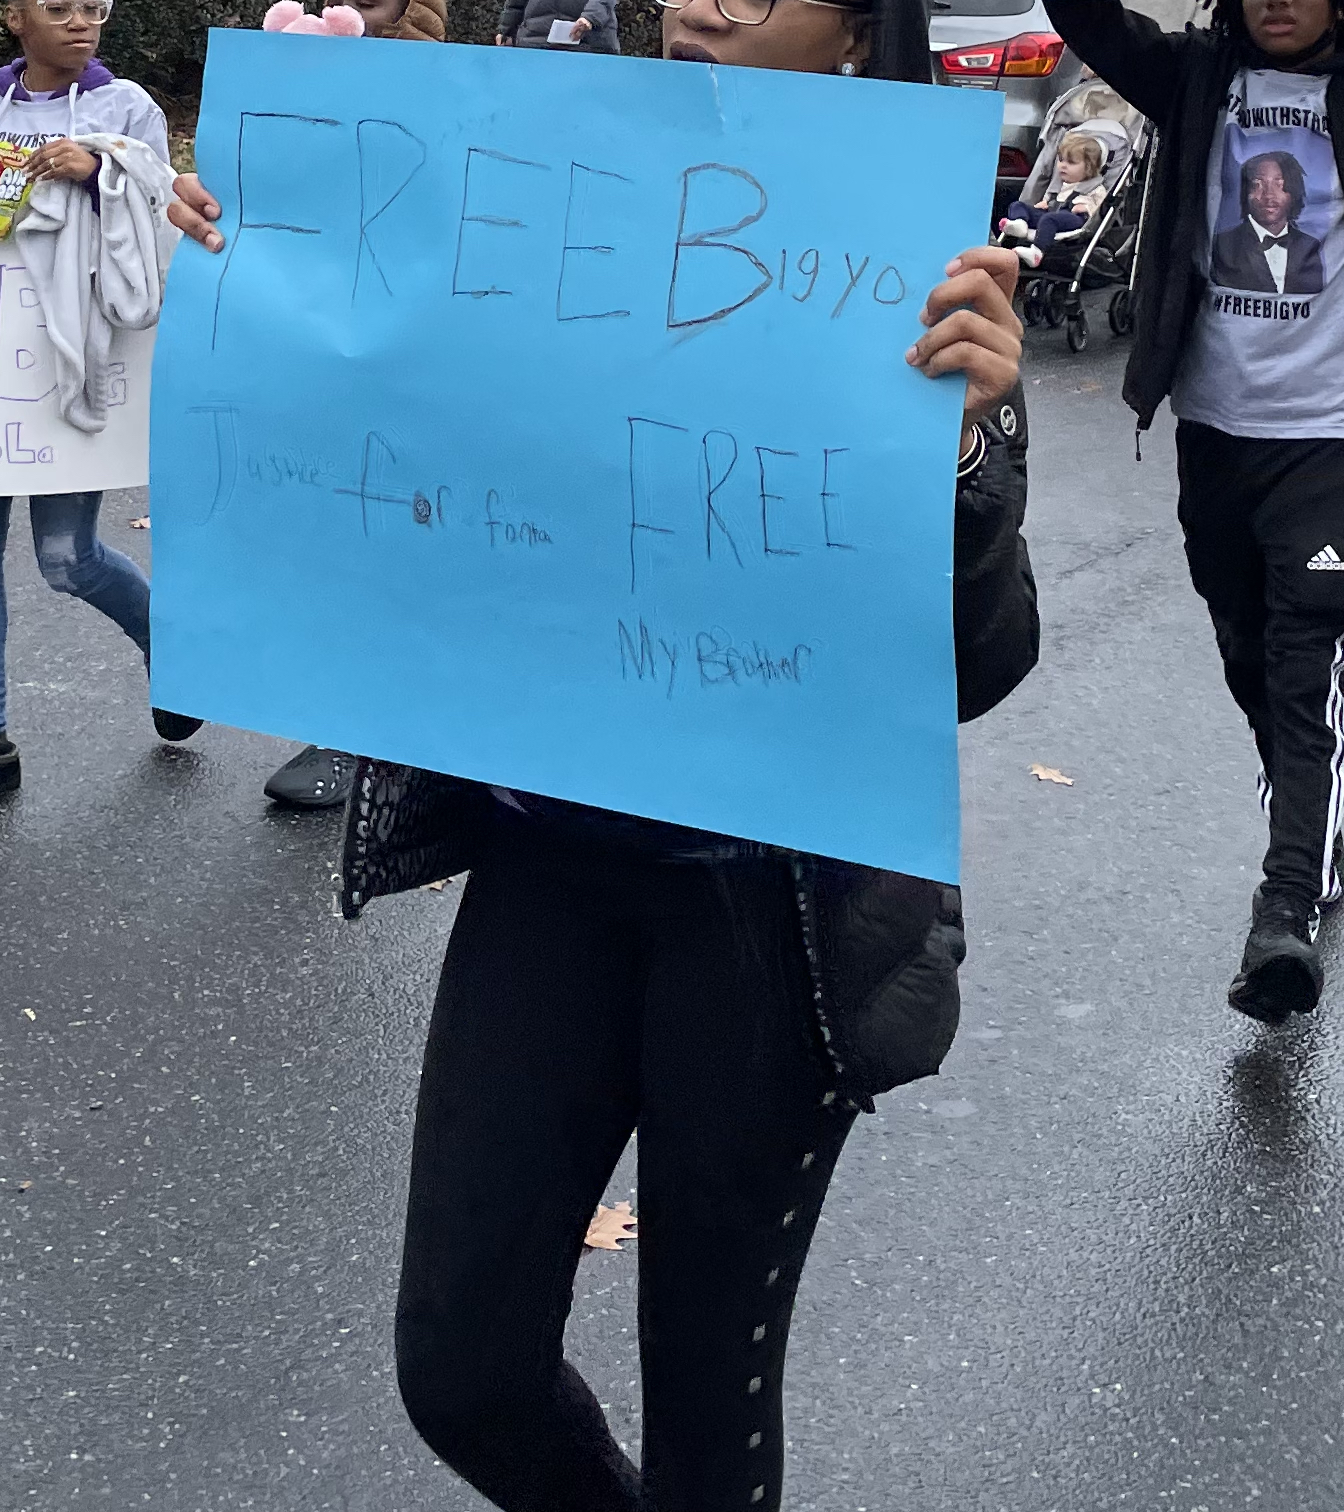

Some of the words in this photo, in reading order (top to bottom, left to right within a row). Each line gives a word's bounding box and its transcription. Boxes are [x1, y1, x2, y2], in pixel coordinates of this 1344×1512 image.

[211, 111, 635, 351] FREE
[1214, 293, 1311, 320] #FREEBIGYO
[627, 416, 858, 594] FREE
